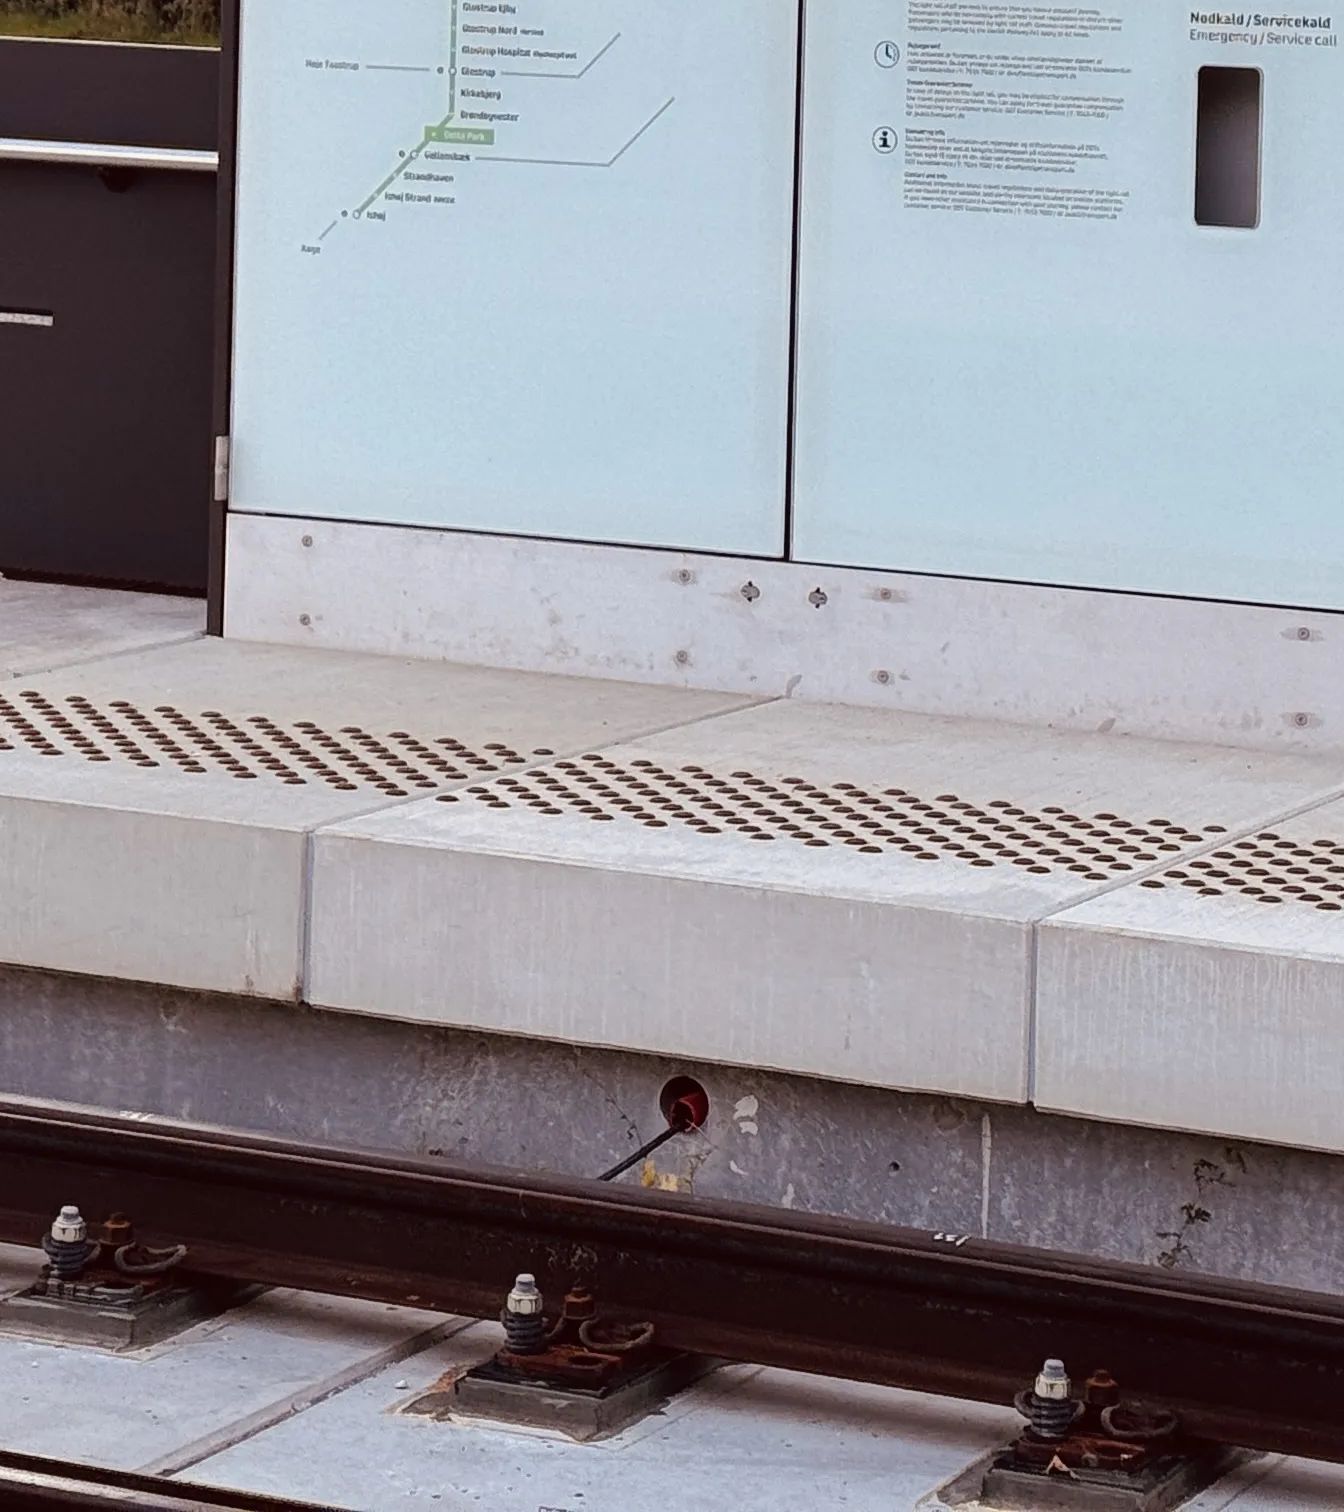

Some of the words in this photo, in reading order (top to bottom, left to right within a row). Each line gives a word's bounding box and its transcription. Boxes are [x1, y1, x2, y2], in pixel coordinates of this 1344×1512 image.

[1254, 14, 1332, 29] Servicekald
[1189, 29, 1258, 46] Emergency
[1267, 32, 1313, 46] Service
[1314, 33, 1338, 48] call
